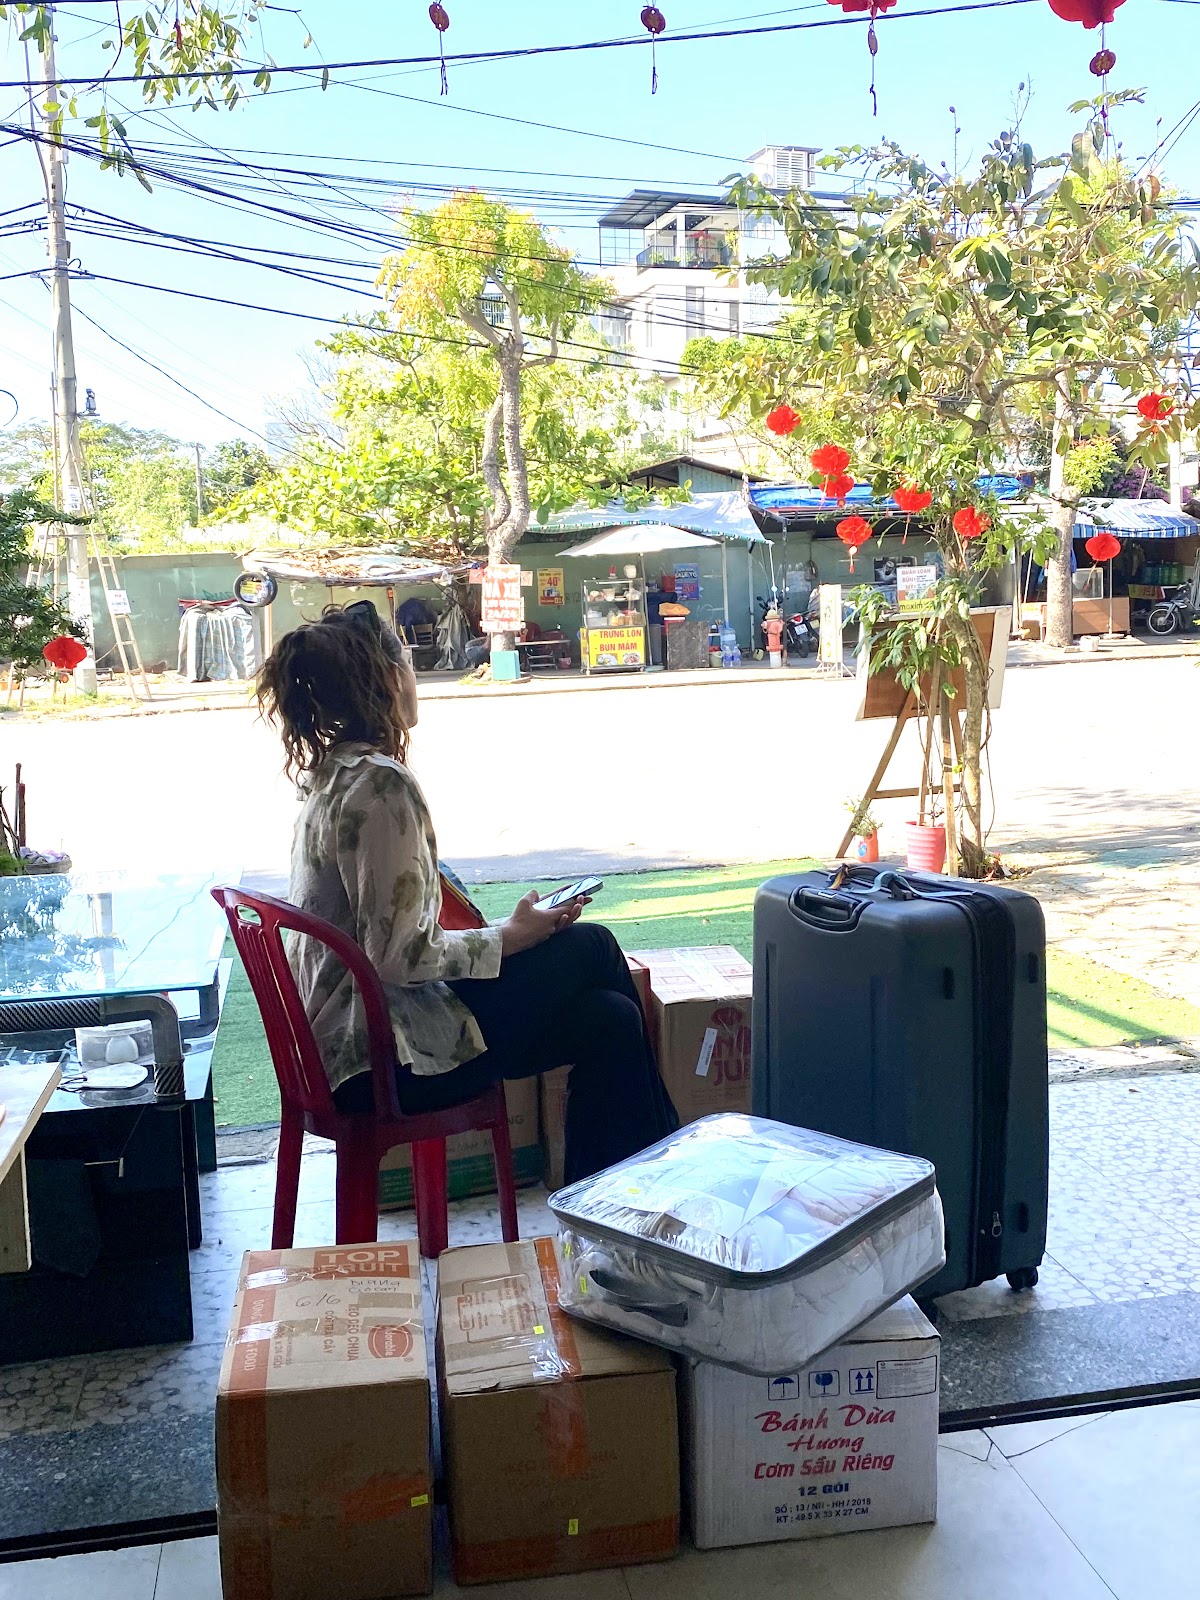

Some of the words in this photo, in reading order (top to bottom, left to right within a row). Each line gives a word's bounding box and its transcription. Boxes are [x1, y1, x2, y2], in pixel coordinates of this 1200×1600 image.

[900, 601, 923, 610] maxim
[321, 1250, 400, 1264] TOP
[320, 1262, 403, 1274] FRUIT
[347, 1336, 360, 1361] CHUA
[244, 1347, 258, 1371] FOOD
[754, 1407, 828, 1433] Bánh
[837, 1404, 897, 1427] Dừa
[786, 1434, 865, 1452] Hương
[754, 1462, 795, 1480] Cơm
[842, 1453, 895, 1472] Riêng
[798, 1486, 817, 1496] 12
[822, 1482, 850, 1494] GÓI
[795, 1504, 805, 1512] 13
[832, 1499, 845, 1508] HH
[852, 1498, 871, 1507] 2018
[776, 1515, 788, 1524] KT
[835, 1509, 841, 1517] X
[843, 1508, 853, 1516] 27
[855, 1507, 869, 1515] CM
